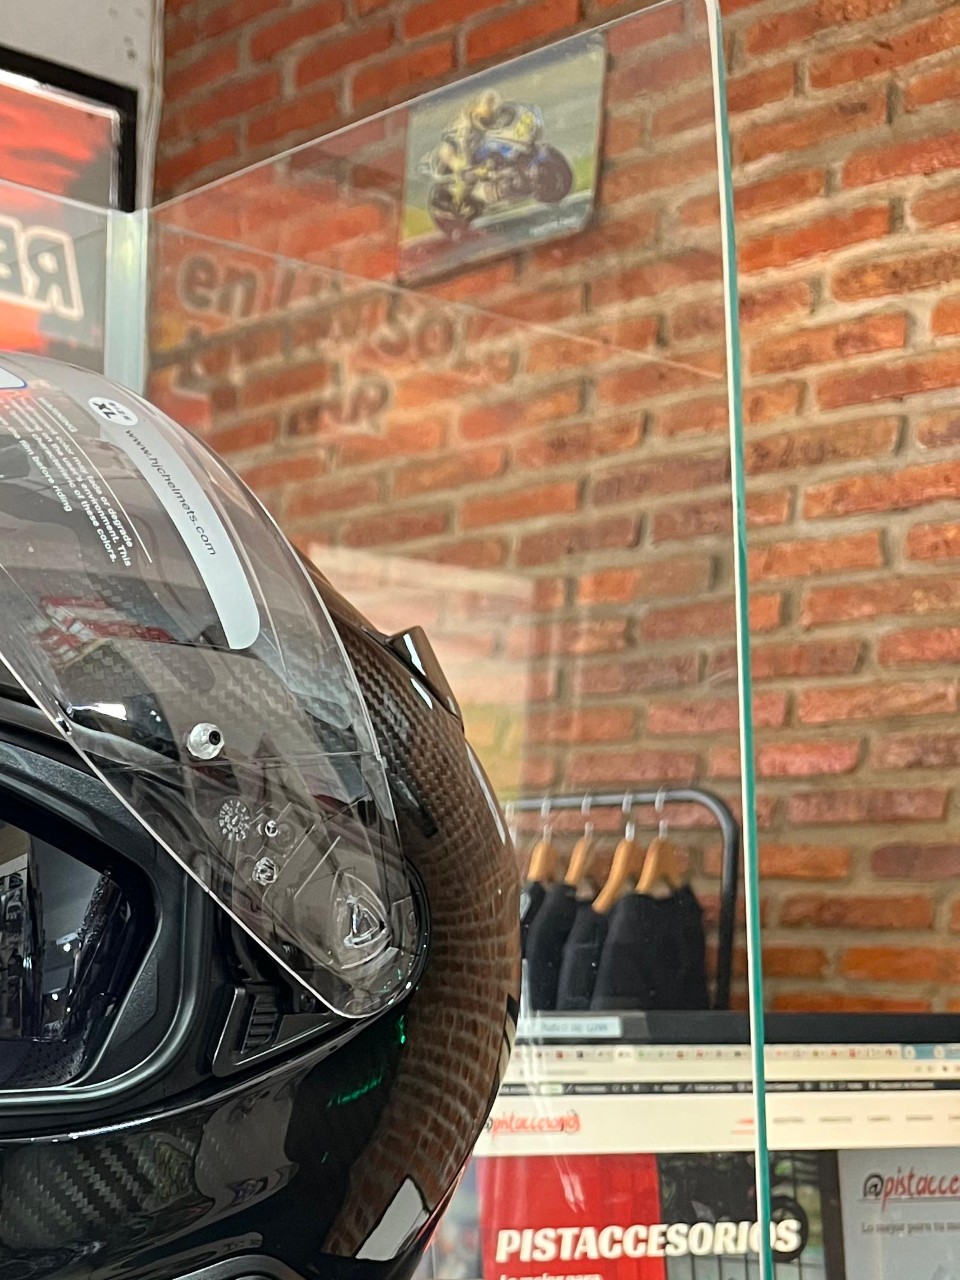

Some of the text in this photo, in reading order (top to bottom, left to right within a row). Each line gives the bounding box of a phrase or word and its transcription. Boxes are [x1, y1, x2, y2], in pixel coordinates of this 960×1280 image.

[92, 402, 117, 419] XL
[31, 455, 55, 484] before
[52, 485, 73, 512] riding
[86, 475, 103, 495] fade
[107, 507, 133, 548] degrade
[125, 429, 217, 556] www.hjchelmets.com
[80, 500, 100, 527] these
[96, 528, 117, 563] colors.
[81, 483, 120, 544] environment.
[117, 544, 132, 567] This
[495, 1219, 802, 1263] PISTACCESORIOS
